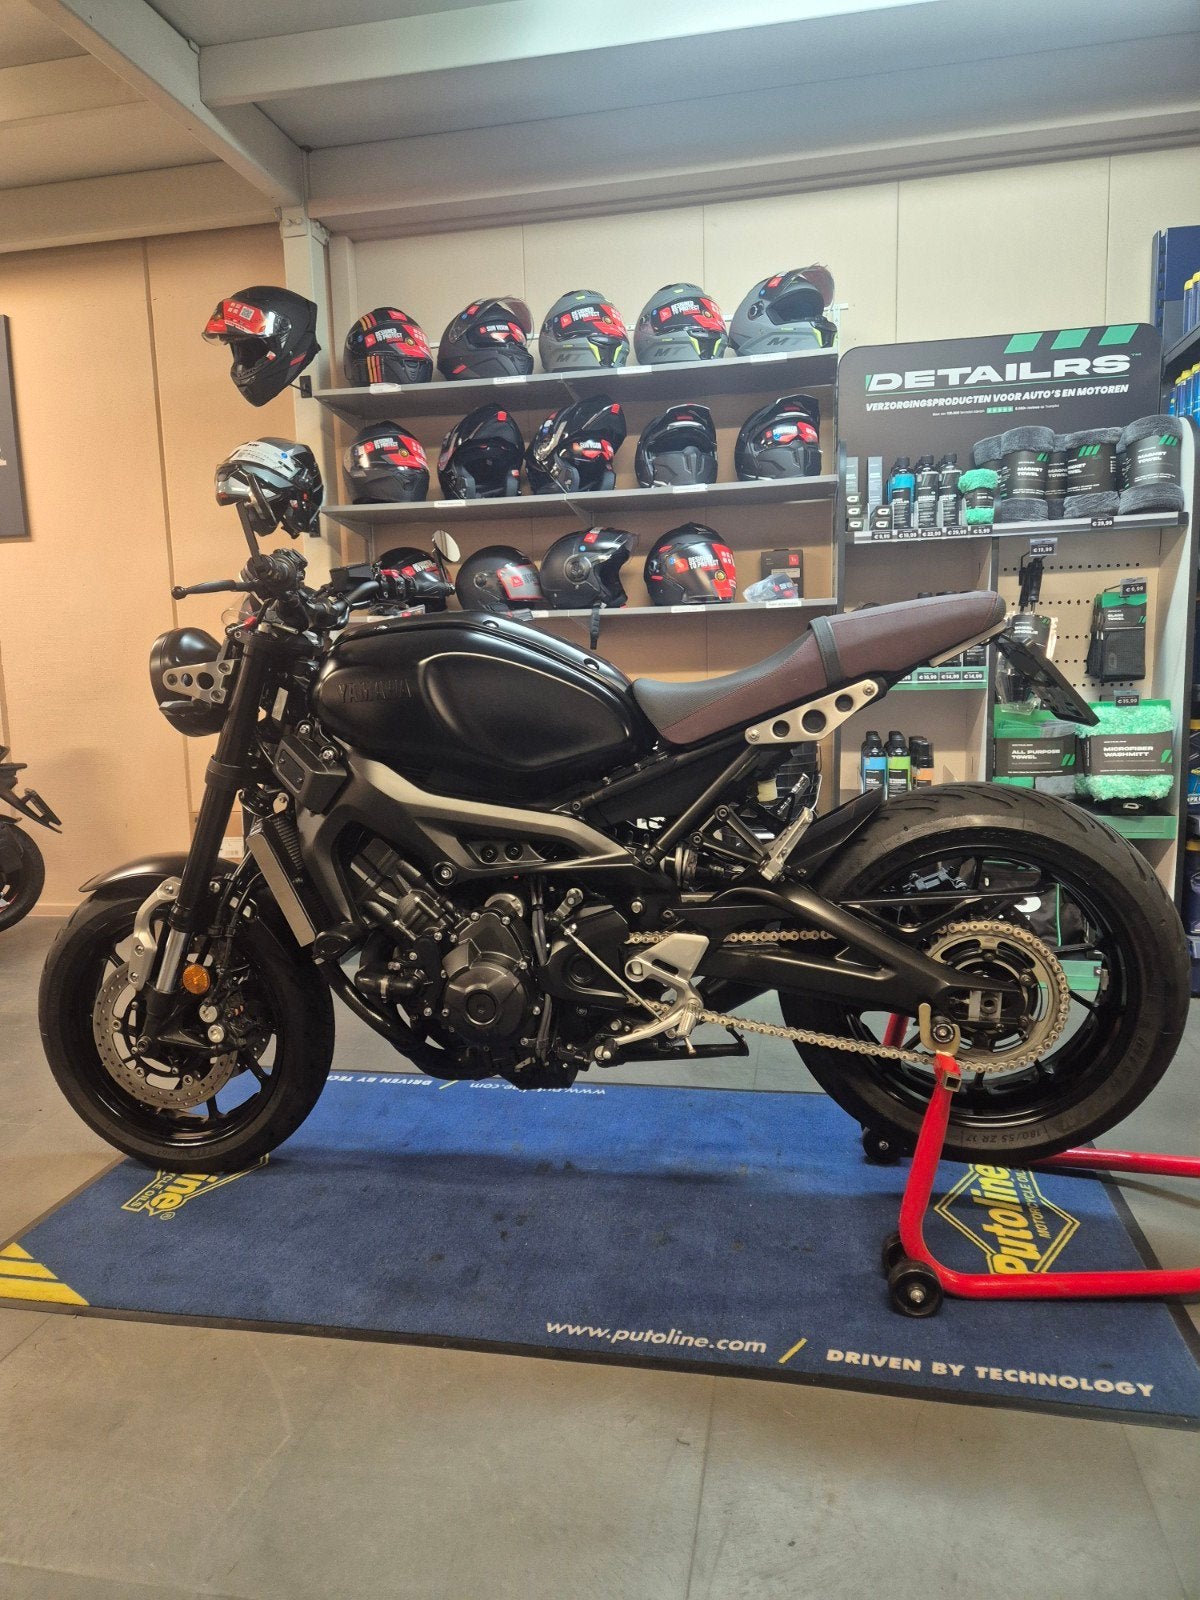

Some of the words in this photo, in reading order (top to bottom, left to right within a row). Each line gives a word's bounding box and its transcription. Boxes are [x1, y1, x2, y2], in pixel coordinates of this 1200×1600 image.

[867, 354, 1131, 392] DETAILRS
[866, 394, 991, 411] VERZORGINGSPRODUCTEN
[993, 391, 1022, 402] VOOR
[1022, 389, 1061, 400] AUTO'S
[1062, 387, 1076, 397] EN
[1076, 384, 1129, 396] MOTOREN
[380, 1078, 433, 1086] DRIVEN
[1018, 1182, 1052, 1238] MOTORCYCLE
[546, 1322, 767, 1354] www.putoline.com
[826, 1349, 922, 1372] DRIVEN
[931, 1361, 966, 1377] BY
[975, 1366, 1154, 1397] TECHNOLOGY
